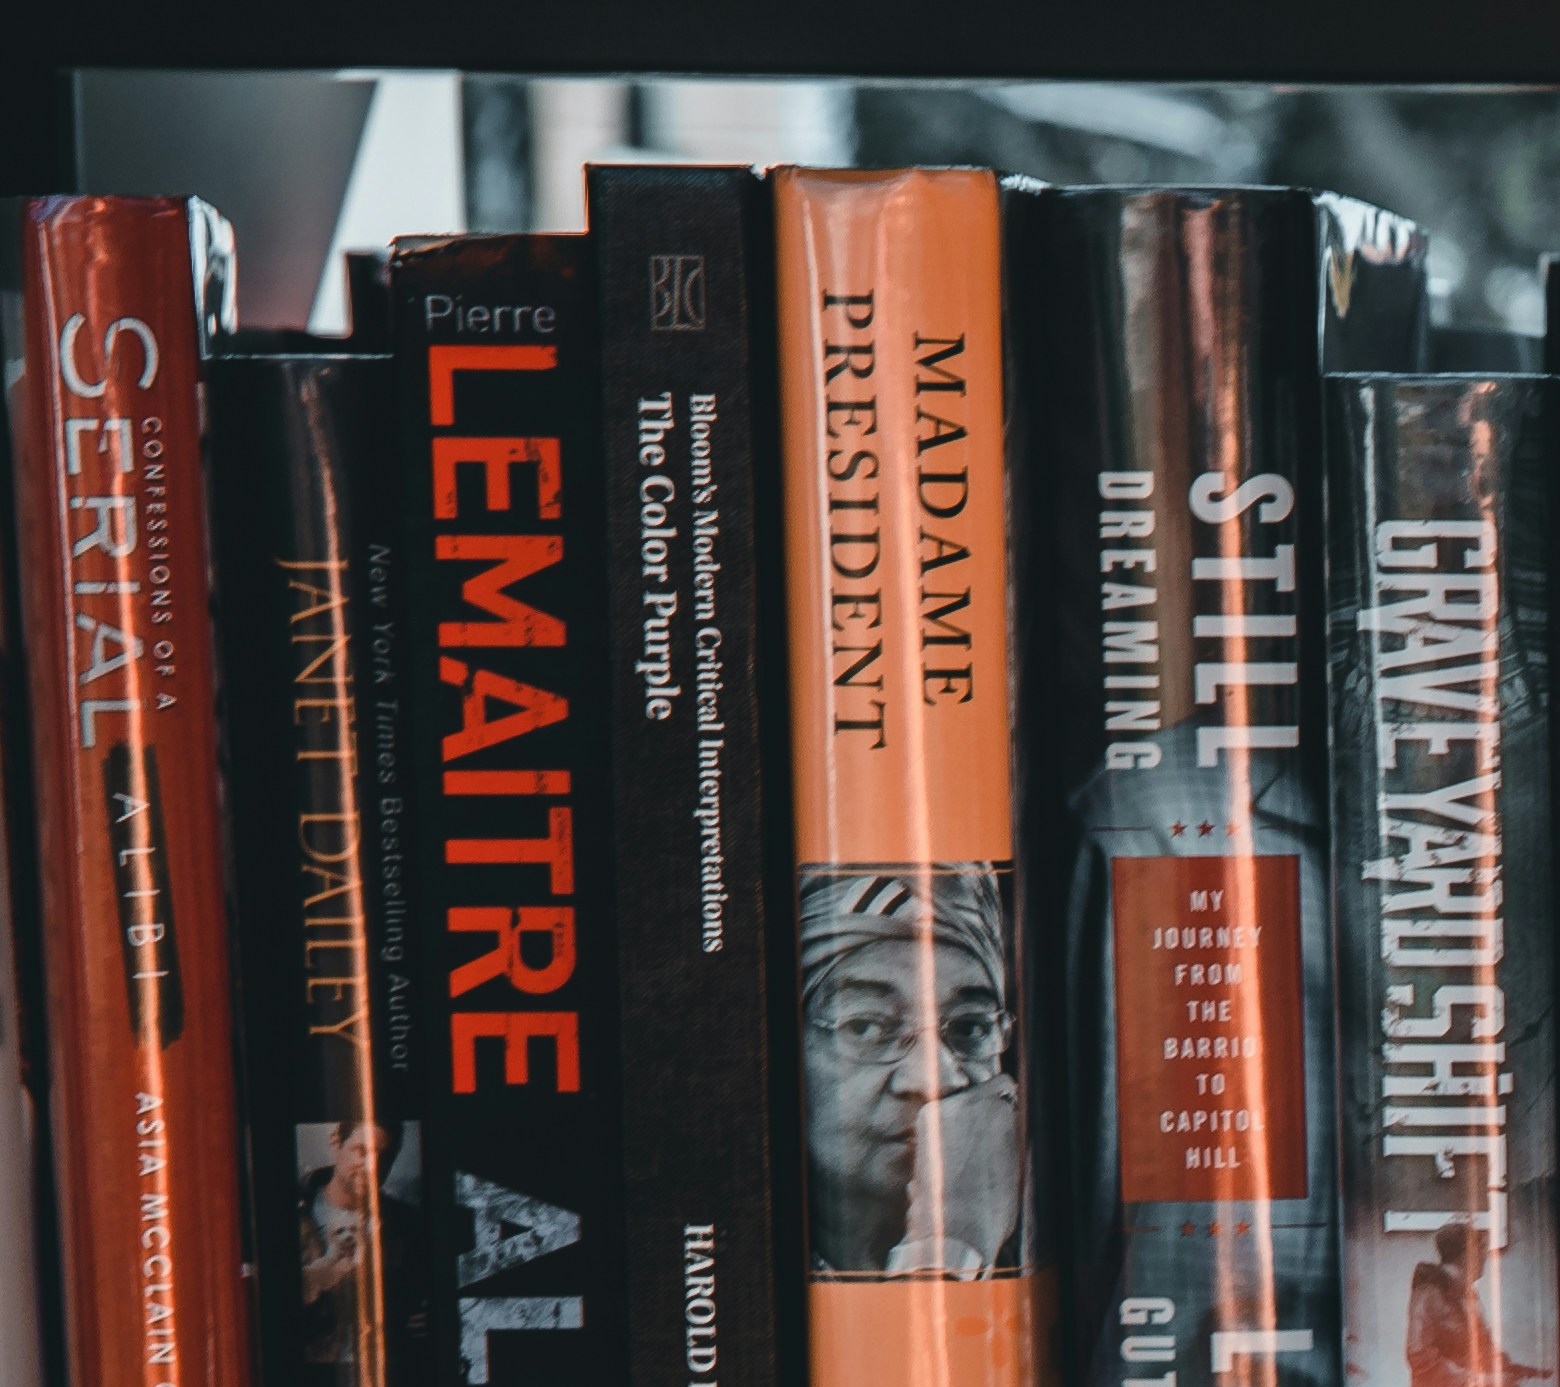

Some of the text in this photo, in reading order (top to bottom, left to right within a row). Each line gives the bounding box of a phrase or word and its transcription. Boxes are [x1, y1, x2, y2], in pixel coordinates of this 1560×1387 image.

[424, 293, 557, 338] Pierre
[59, 314, 160, 750] SERIAL
[639, 391, 672, 720] The Color Purple
[690, 392, 727, 953] Bloom's Modern Critical Interpretations
[428, 344, 582, 1093] LEMAITRE
[134, 1088, 166, 1178] ASIA
[142, 1191, 173, 1365] MCCLAIN
